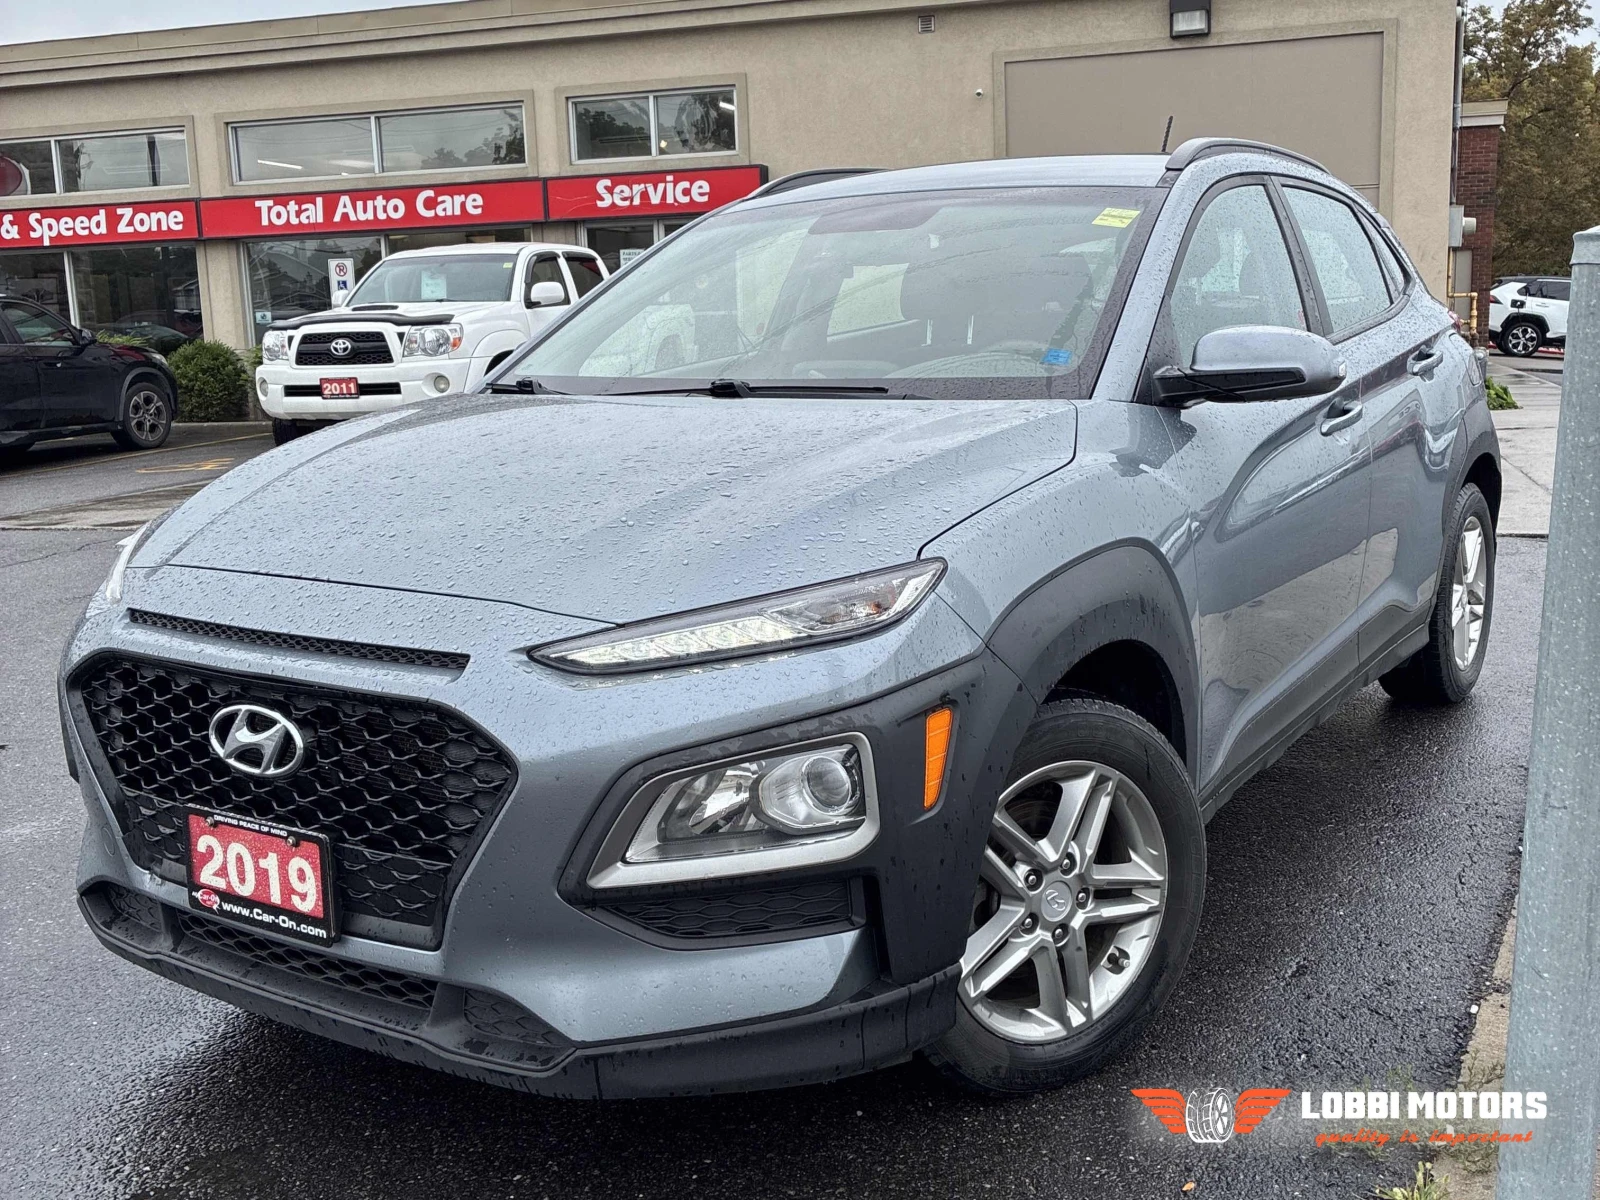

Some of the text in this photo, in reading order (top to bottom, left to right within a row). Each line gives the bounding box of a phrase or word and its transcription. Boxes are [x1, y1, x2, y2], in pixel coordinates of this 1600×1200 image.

[255, 189, 484, 226] Total Auto Care
[596, 175, 710, 208] Service
[0, 207, 184, 246] & Speed Zone
[323, 382, 356, 394] 2011
[213, 814, 288, 837] DRIVING PEACE OF MIND
[196, 834, 317, 913] 2019
[221, 901, 327, 939] www.Car-On.com
